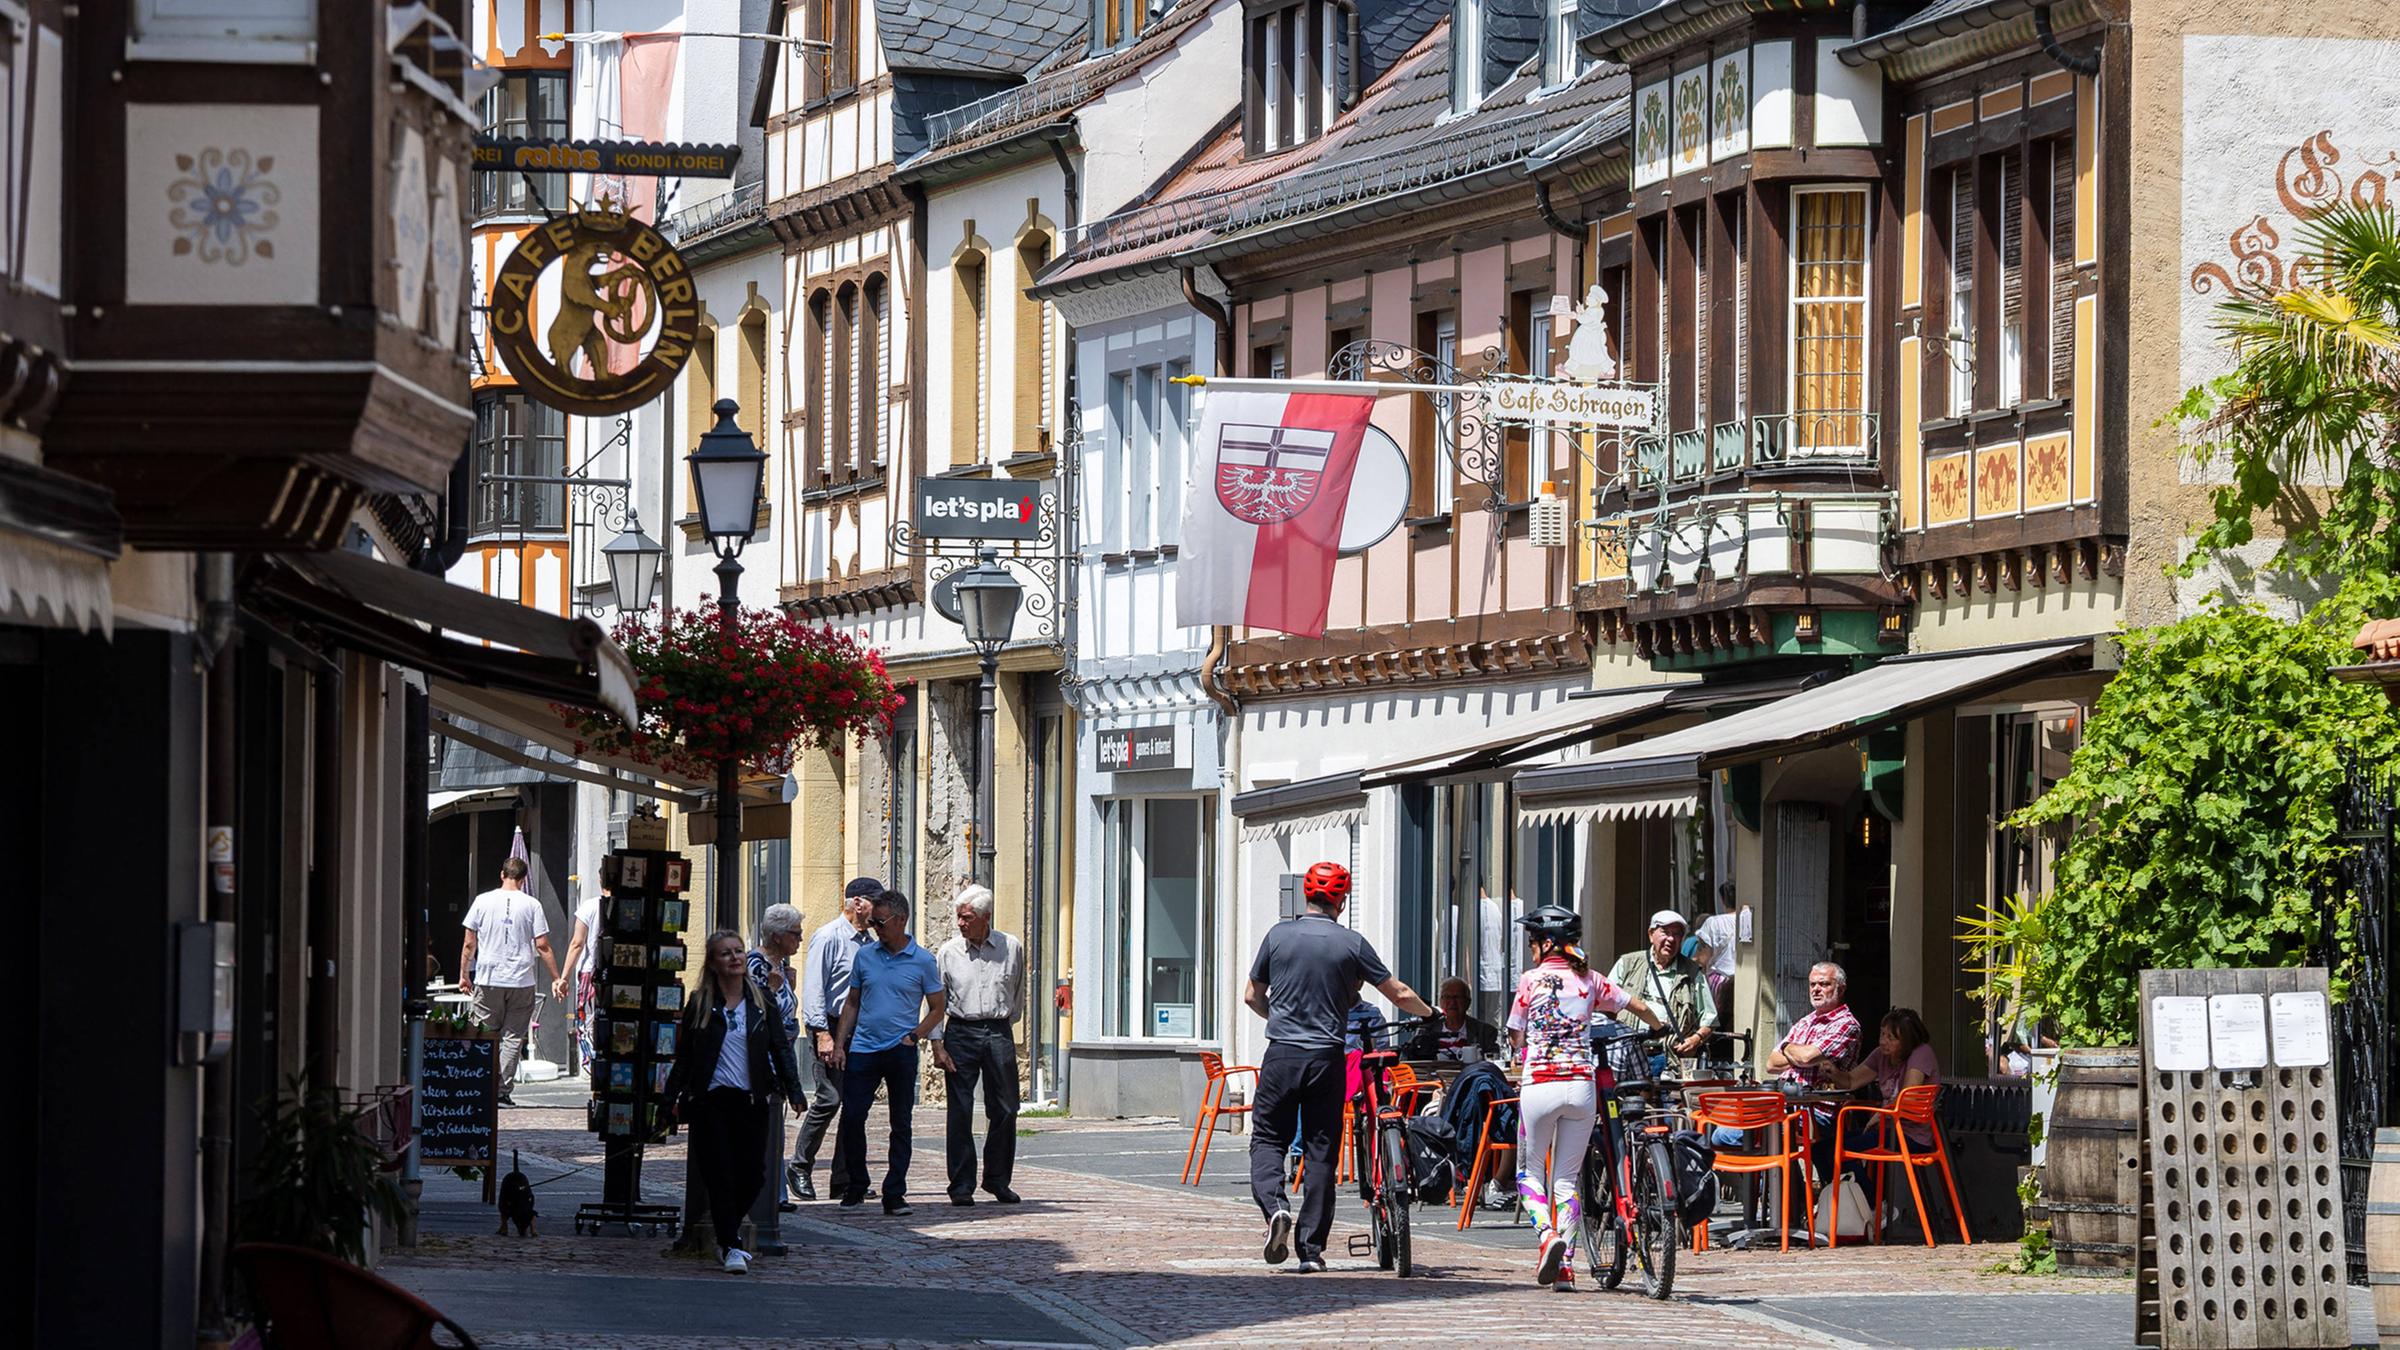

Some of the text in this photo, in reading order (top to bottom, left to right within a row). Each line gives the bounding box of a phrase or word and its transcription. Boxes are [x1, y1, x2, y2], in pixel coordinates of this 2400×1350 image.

[630, 228, 696, 370] BERLIN
[1498, 386, 1647, 421] Cafe Schragen
